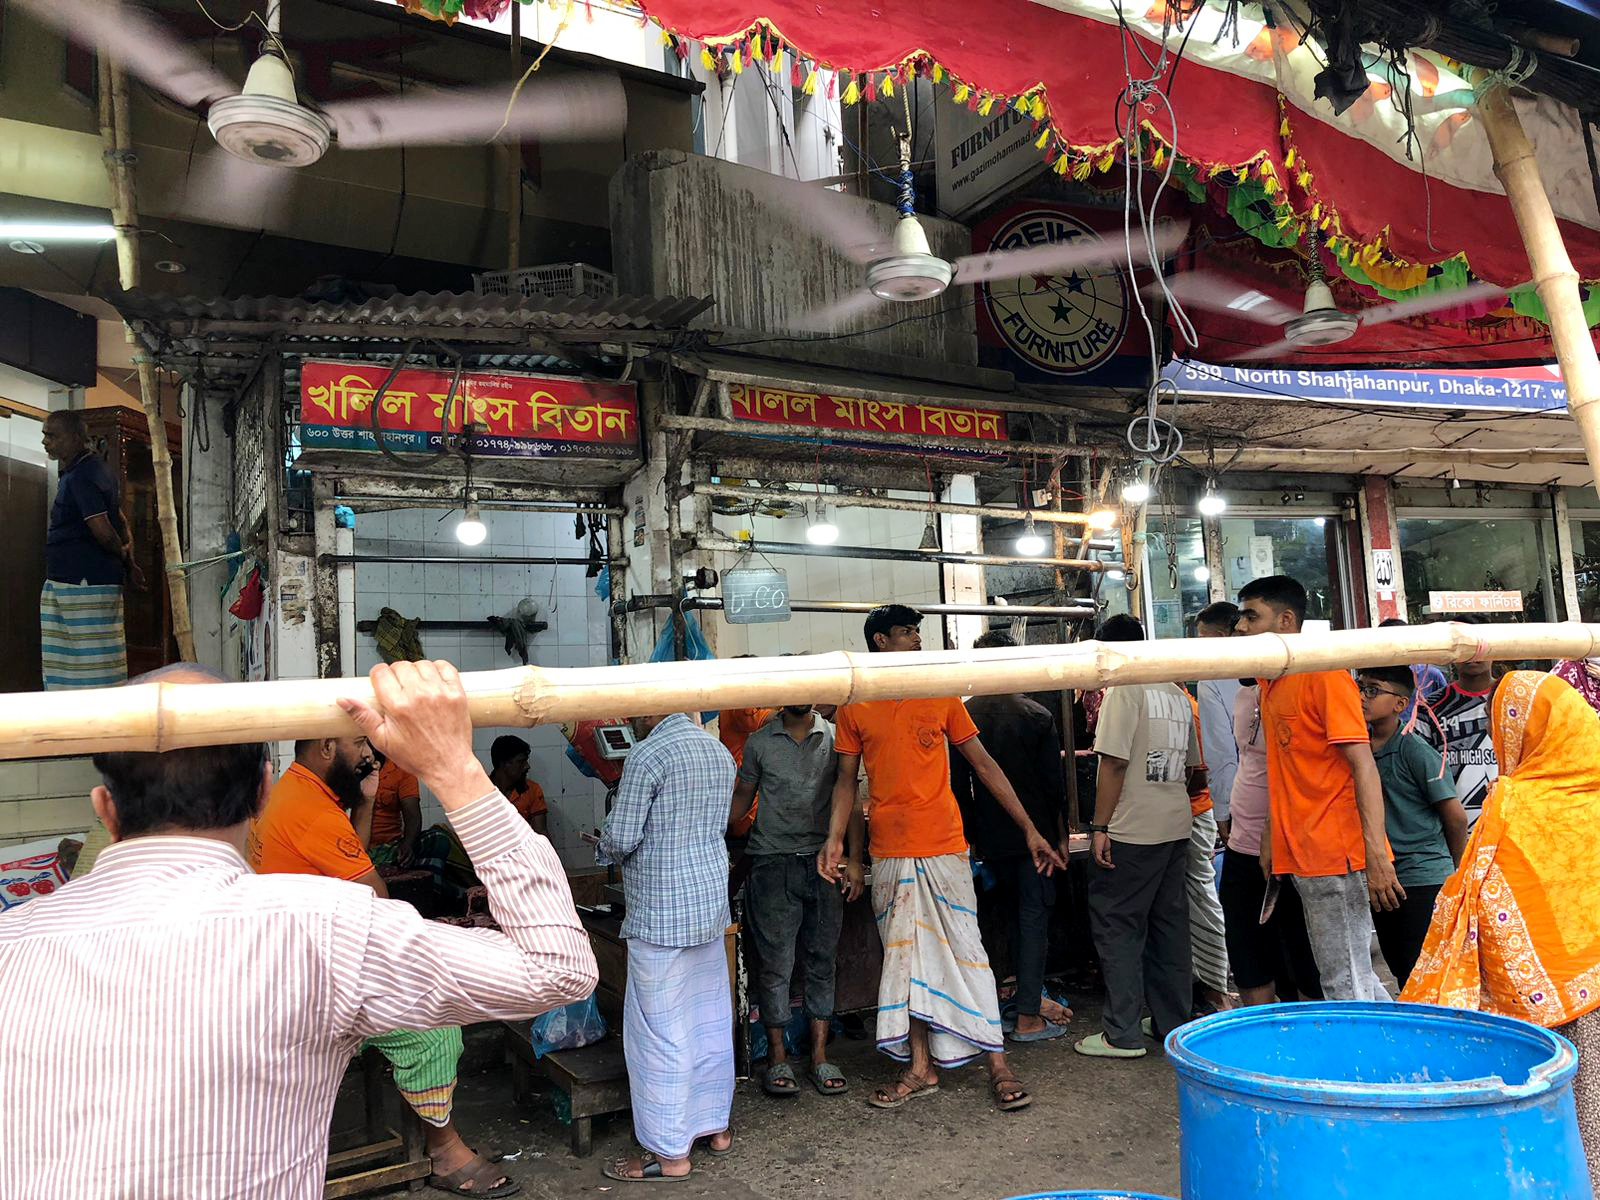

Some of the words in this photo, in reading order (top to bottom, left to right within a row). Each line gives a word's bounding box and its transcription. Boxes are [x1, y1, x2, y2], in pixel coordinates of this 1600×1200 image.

[951, 110, 1024, 169] FURNITU
[1003, 311, 1116, 364] FURNITURE
[1234, 368, 1291, 386] North
[1297, 370, 1434, 396] Shahjahanpur,
[307, 375, 420, 425] খলিল
[427, 388, 520, 434] মাংস
[527, 390, 632, 439] বিতান
[828, 395, 911, 432] মাংস
[306, 427, 329, 439] ৬০০
[332, 426, 355, 440] উত্তর
[1460, 748, 1482, 766] HIGH
